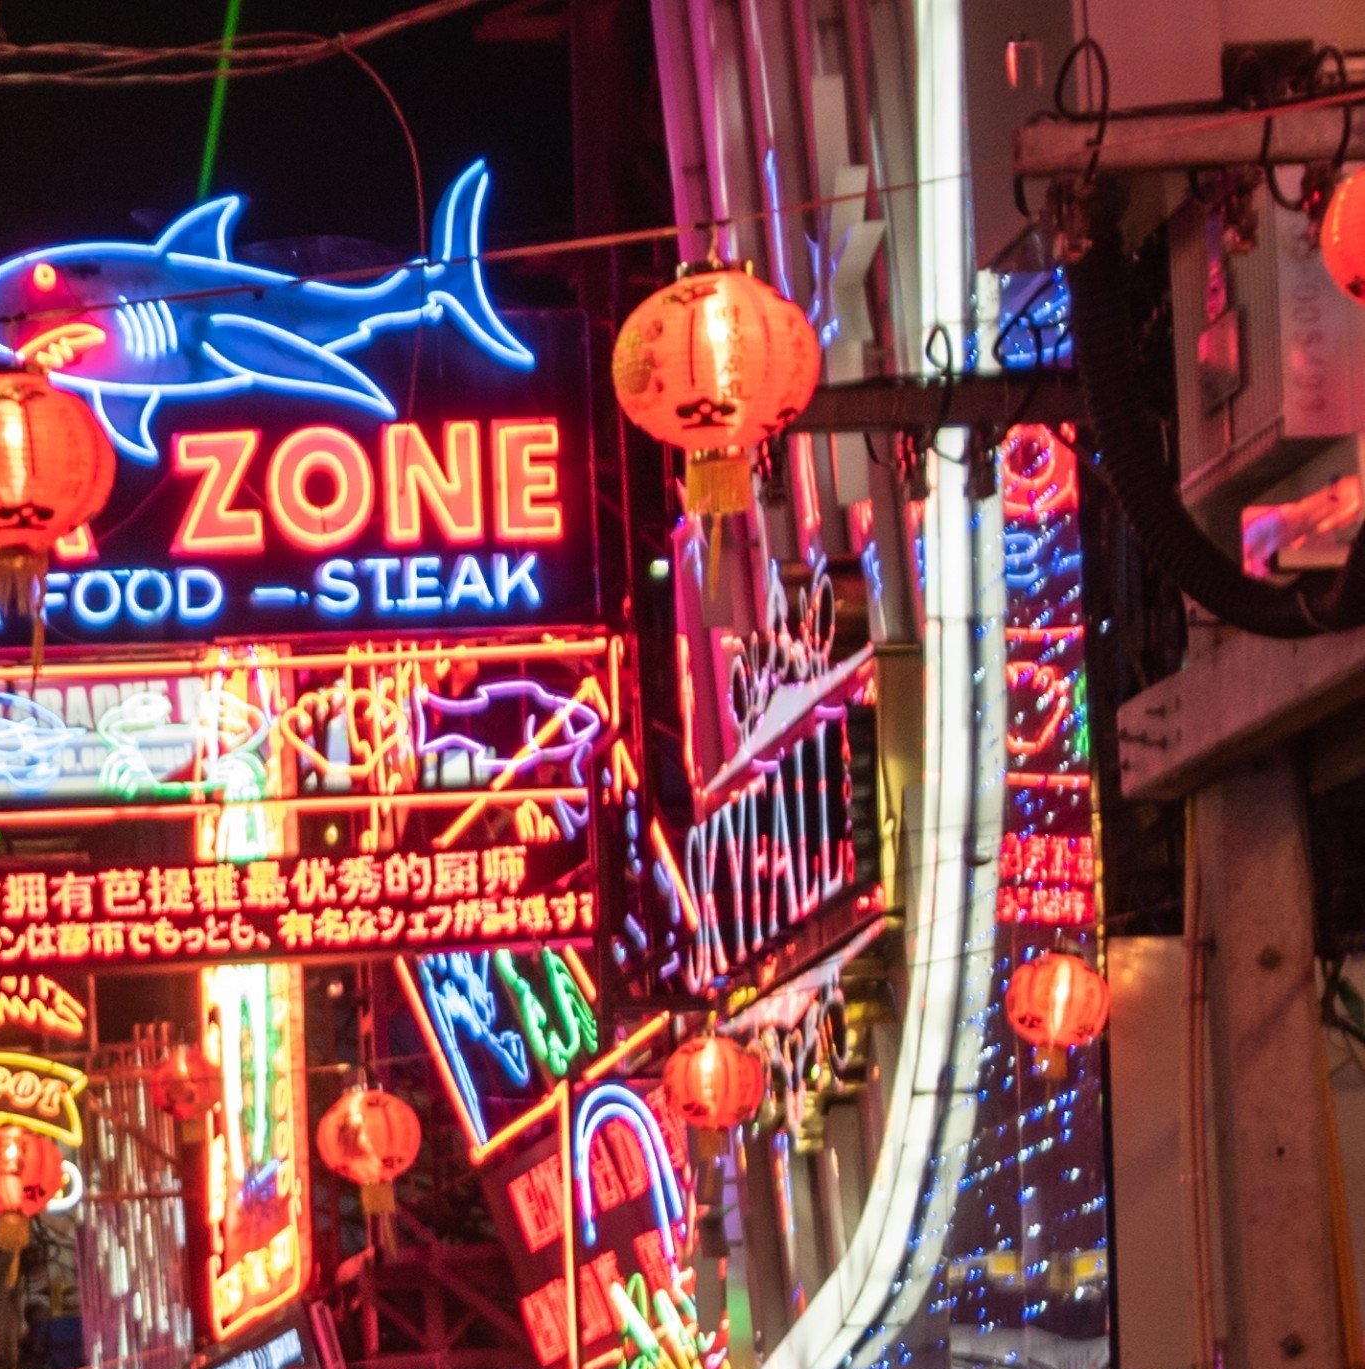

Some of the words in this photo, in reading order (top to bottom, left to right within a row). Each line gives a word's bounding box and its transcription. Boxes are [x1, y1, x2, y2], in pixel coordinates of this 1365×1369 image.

[172, 416, 564, 558] ZONE
[34, 566, 222, 624] FOOD
[313, 551, 543, 614] STEAK
